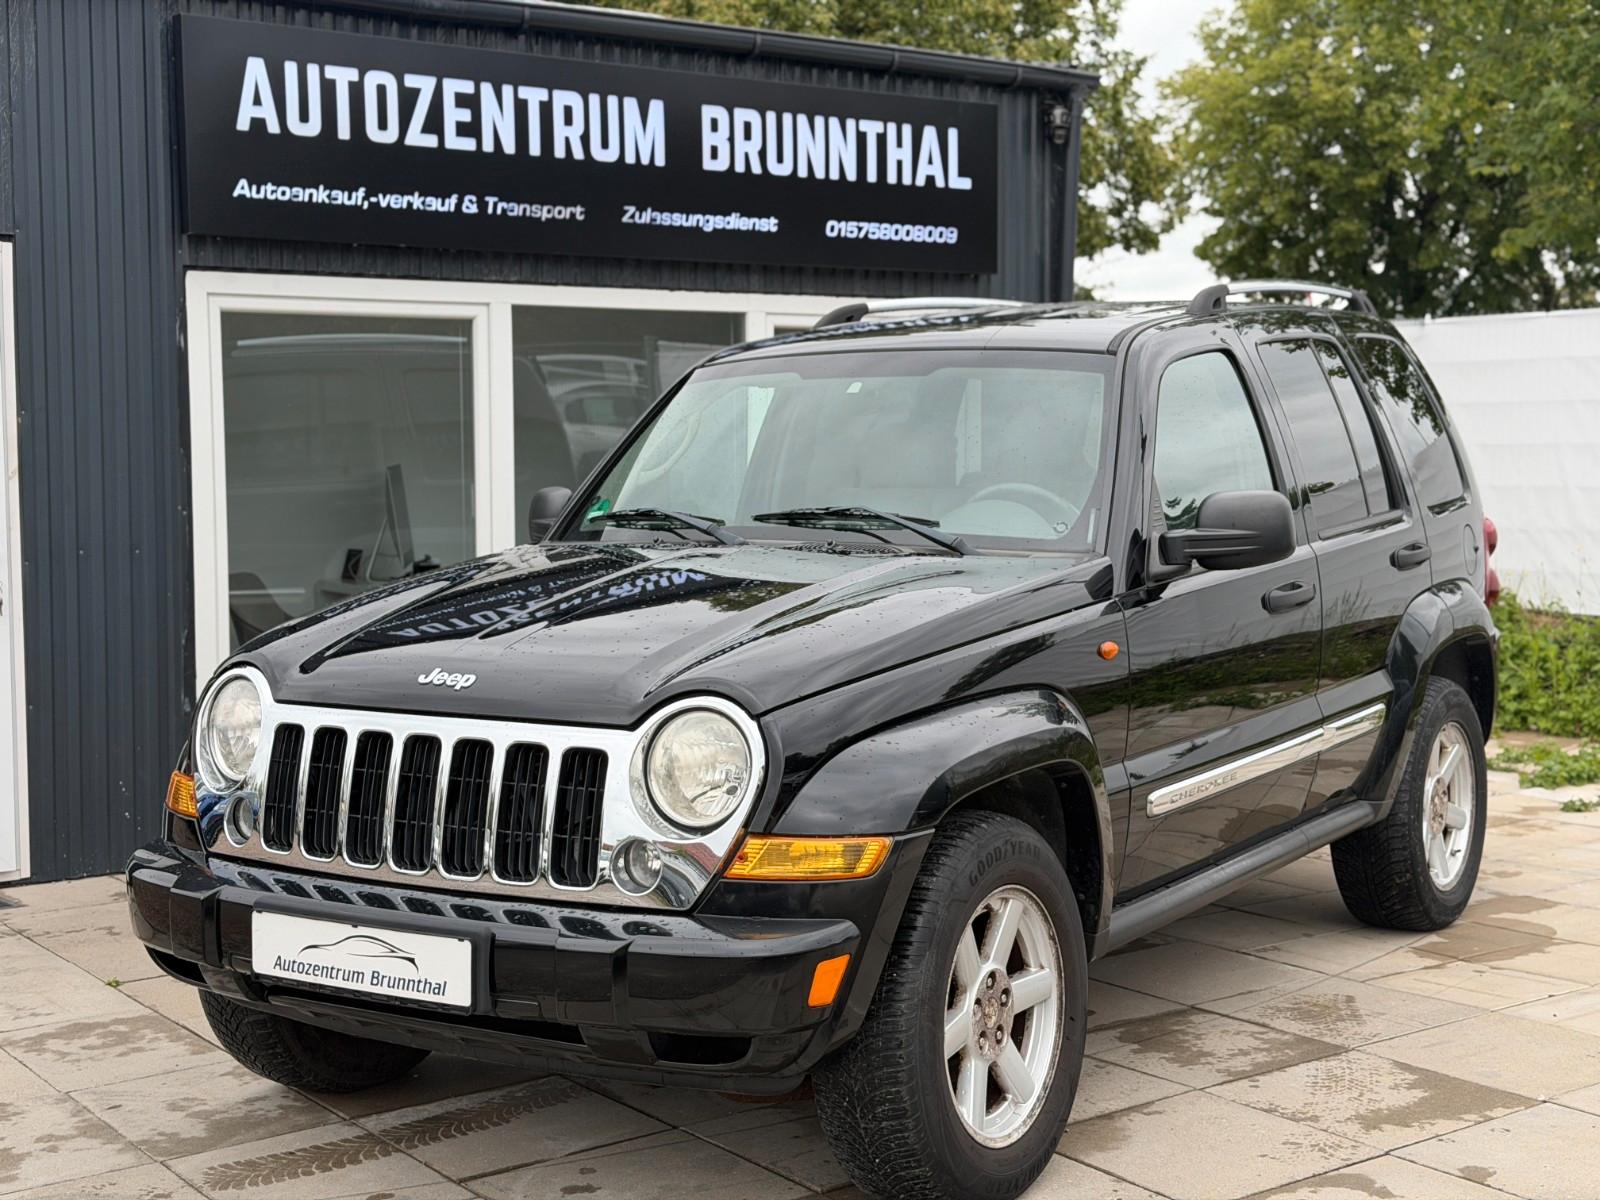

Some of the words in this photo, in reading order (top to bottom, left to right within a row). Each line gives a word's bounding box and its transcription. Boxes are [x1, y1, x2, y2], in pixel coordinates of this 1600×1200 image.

[235, 56, 667, 168] AUTOZENTRUM
[701, 104, 973, 190] BRUNNTHAL
[461, 195, 479, 214] &
[484, 196, 586, 222] Transport
[621, 205, 779, 233] Zulassungsdienst
[825, 219, 959, 244] 015758008009
[417, 667, 477, 691] Jeep
[1169, 771, 1239, 805] CHEROKEE
[968, 838, 1041, 887] GOODYEAR
[273, 954, 365, 985] Autozentrum
[370, 970, 448, 997] Brunnthal
